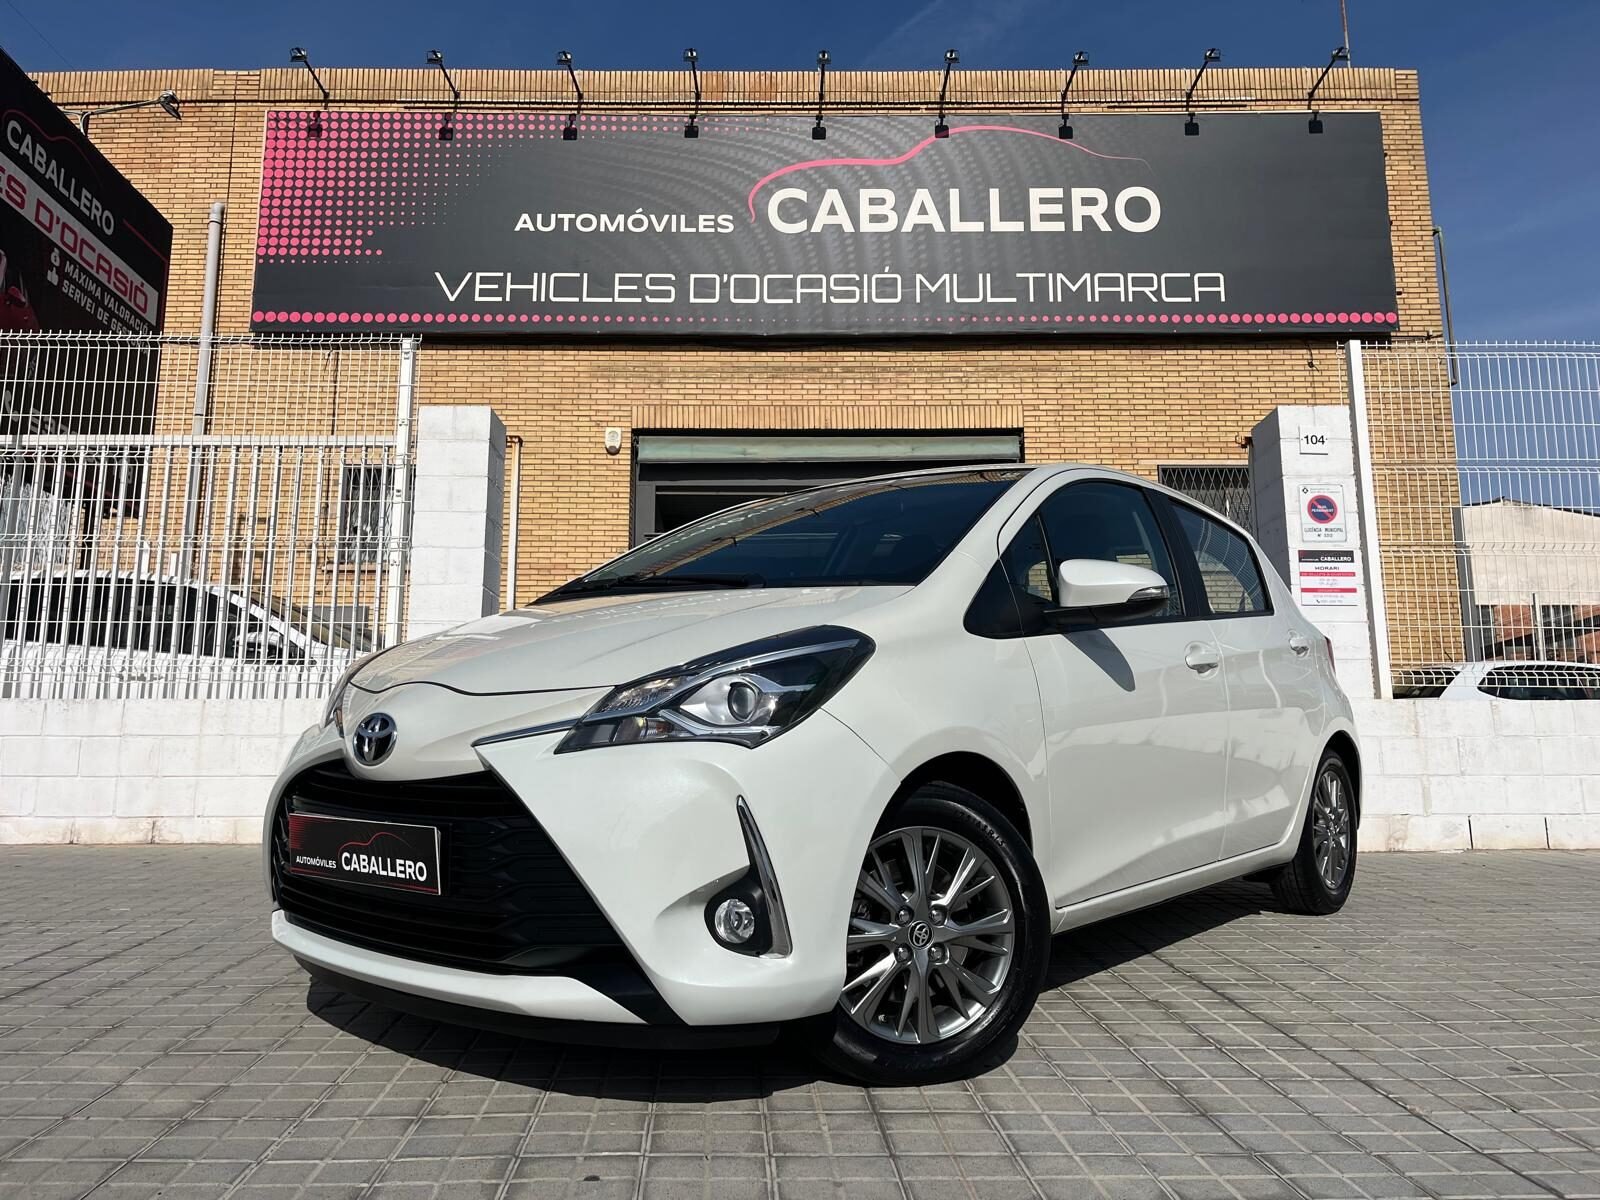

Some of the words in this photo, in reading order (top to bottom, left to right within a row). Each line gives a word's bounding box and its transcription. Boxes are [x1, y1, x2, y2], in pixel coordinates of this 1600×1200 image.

[7, 120, 115, 236] CABALLERO
[514, 207, 735, 234] AUTOMÓVILES
[767, 186, 1161, 234] CABALLERO
[35, 198, 148, 315] D'OCASIÓ
[62, 279, 96, 315] SERVEI
[97, 307, 110, 325] DE
[434, 271, 676, 303] VEHICLES
[689, 266, 902, 304] D'OCASIÓ
[915, 272, 1226, 304] MULTIMARCA
[104, 291, 148, 335] VALORACIÓ
[1303, 434, 1326, 445] 104
[295, 855, 337, 869] AUTOMÓVILES
[341, 851, 427, 882] CABALLERO
